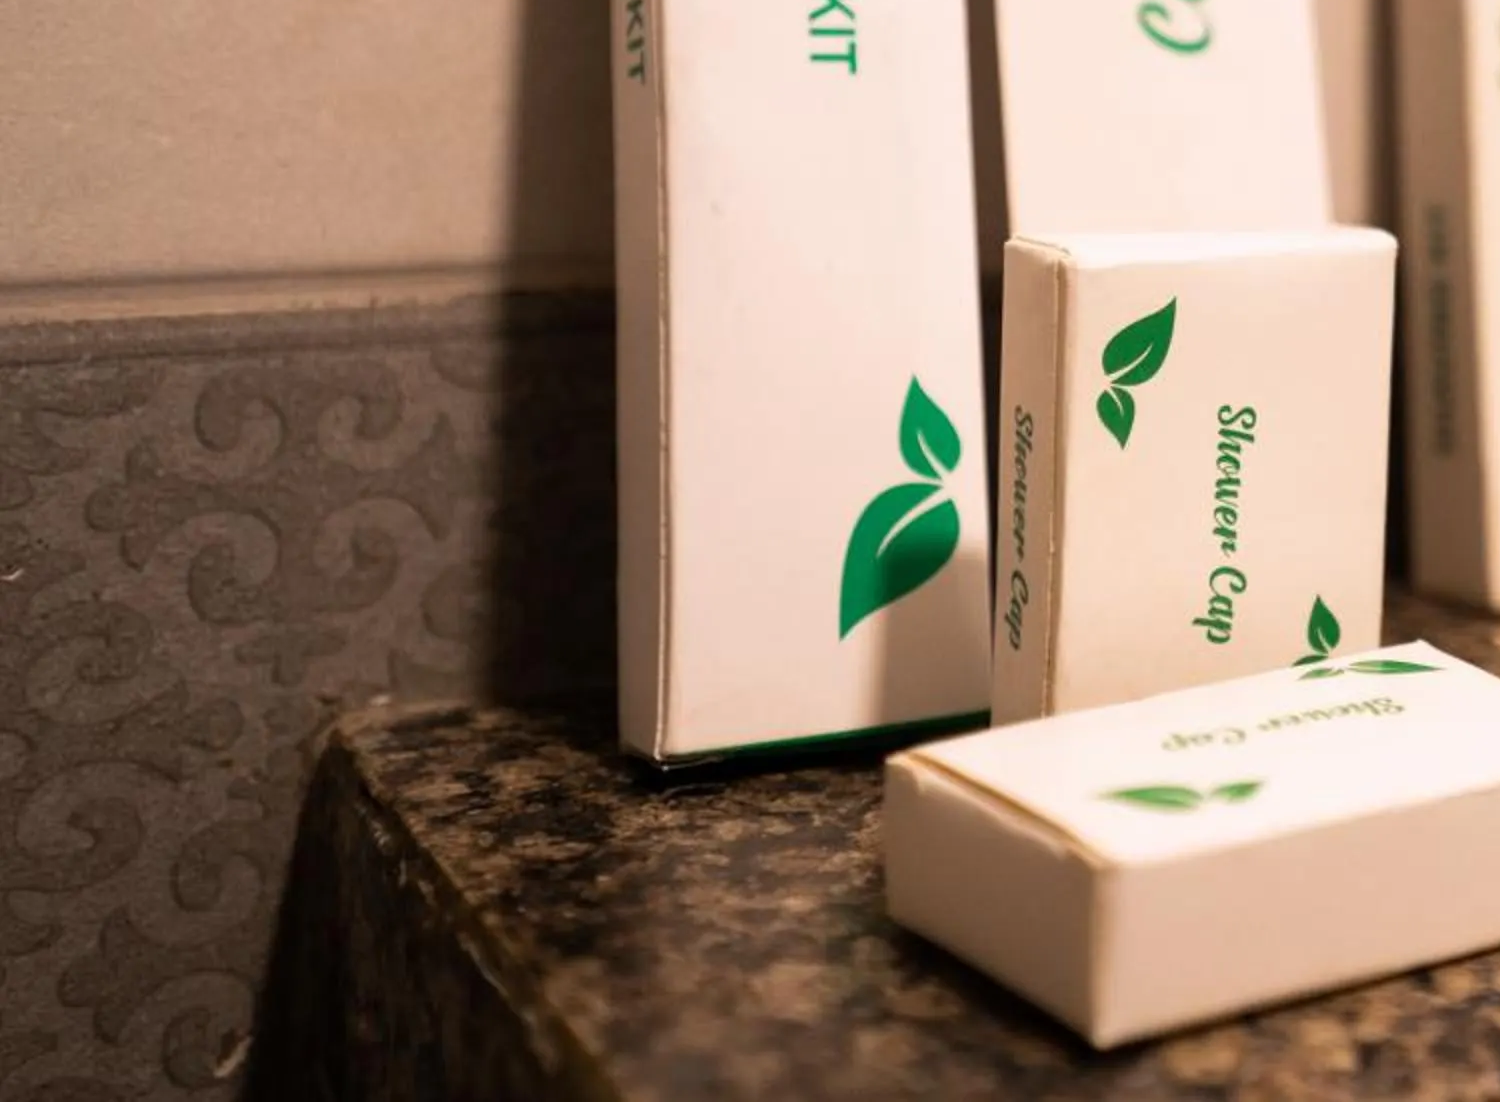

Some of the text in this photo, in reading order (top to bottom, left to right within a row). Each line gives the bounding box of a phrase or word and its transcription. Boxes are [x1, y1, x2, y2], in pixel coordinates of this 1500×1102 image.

[1003, 403, 1033, 652] Shower Cap
[1191, 403, 1258, 645] Shower Cap
[1257, 696, 1406, 732] Shower
